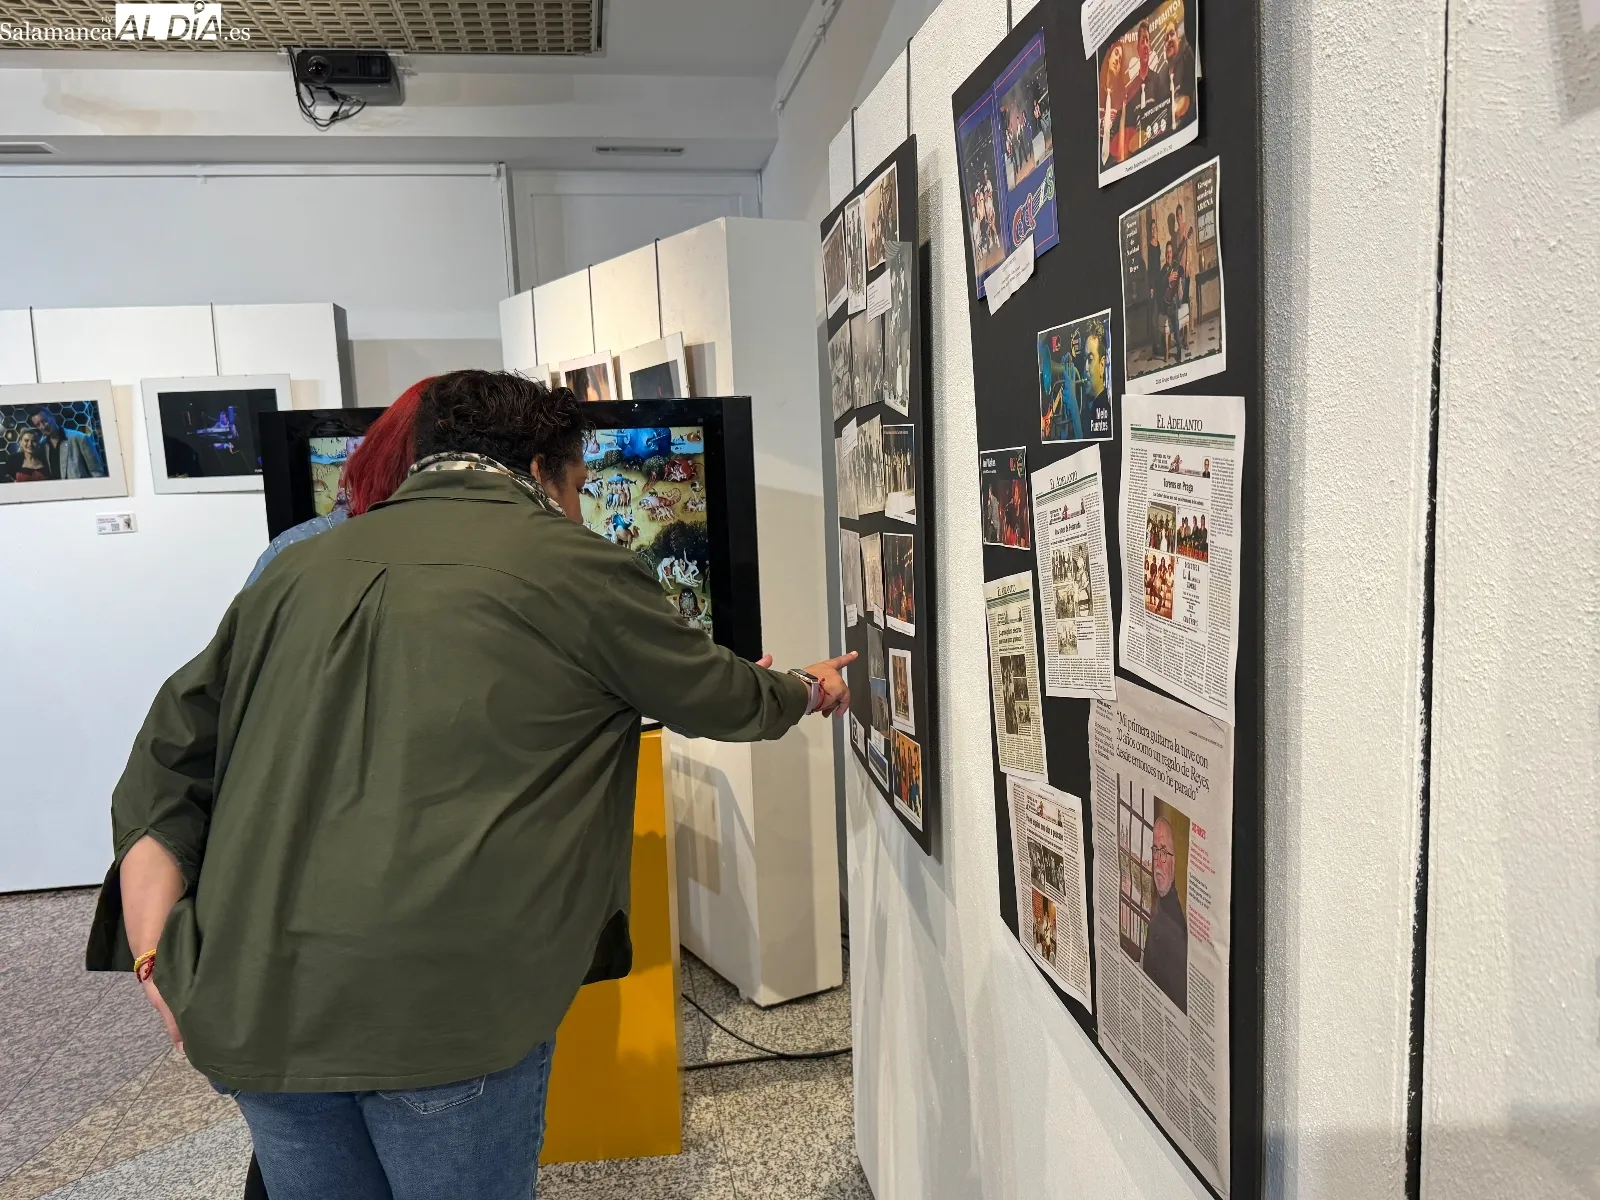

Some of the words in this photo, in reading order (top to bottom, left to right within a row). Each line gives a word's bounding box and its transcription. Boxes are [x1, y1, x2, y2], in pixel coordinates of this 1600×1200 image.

[1156, 414, 1165, 429] EL
[1166, 415, 1203, 431] ADELANTO
[1116, 743, 1132, 763] desde
[1132, 755, 1157, 778] entonces
[1157, 769, 1166, 783] no
[1165, 770, 1174, 788] he
[1123, 732, 1136, 749] años
[1136, 741, 1153, 758] como
[1153, 749, 1161, 763] un
[1162, 755, 1181, 773] regalo
[1181, 761, 1190, 778] de
[1127, 718, 1150, 738] primera
[1150, 730, 1174, 751] guitarra
[1174, 738, 1181, 755] la
[1181, 745, 1196, 762] tuve
[1196, 754, 1209, 770] con
